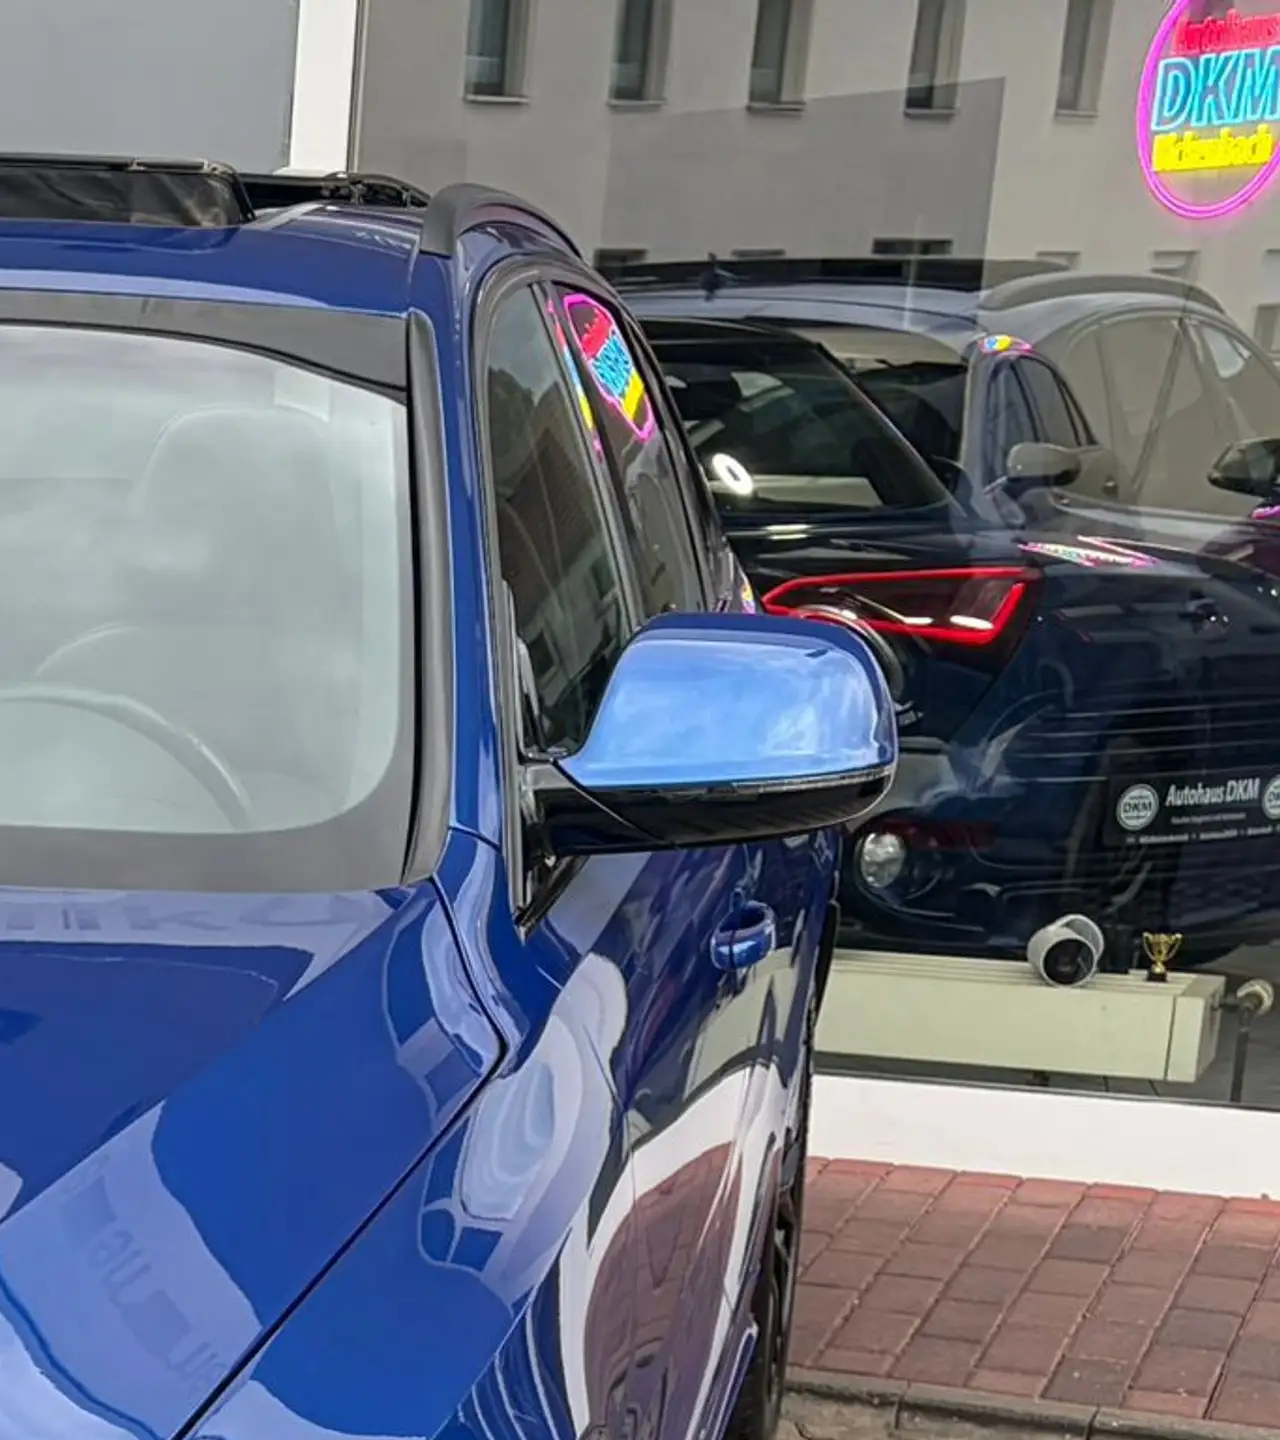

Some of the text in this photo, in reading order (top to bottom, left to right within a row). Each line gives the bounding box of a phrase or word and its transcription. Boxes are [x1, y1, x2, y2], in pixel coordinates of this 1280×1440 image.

[1151, 46, 1280, 131] DKM
[1166, 783, 1224, 806] Autohaus
[1226, 778, 1261, 801] DKM
